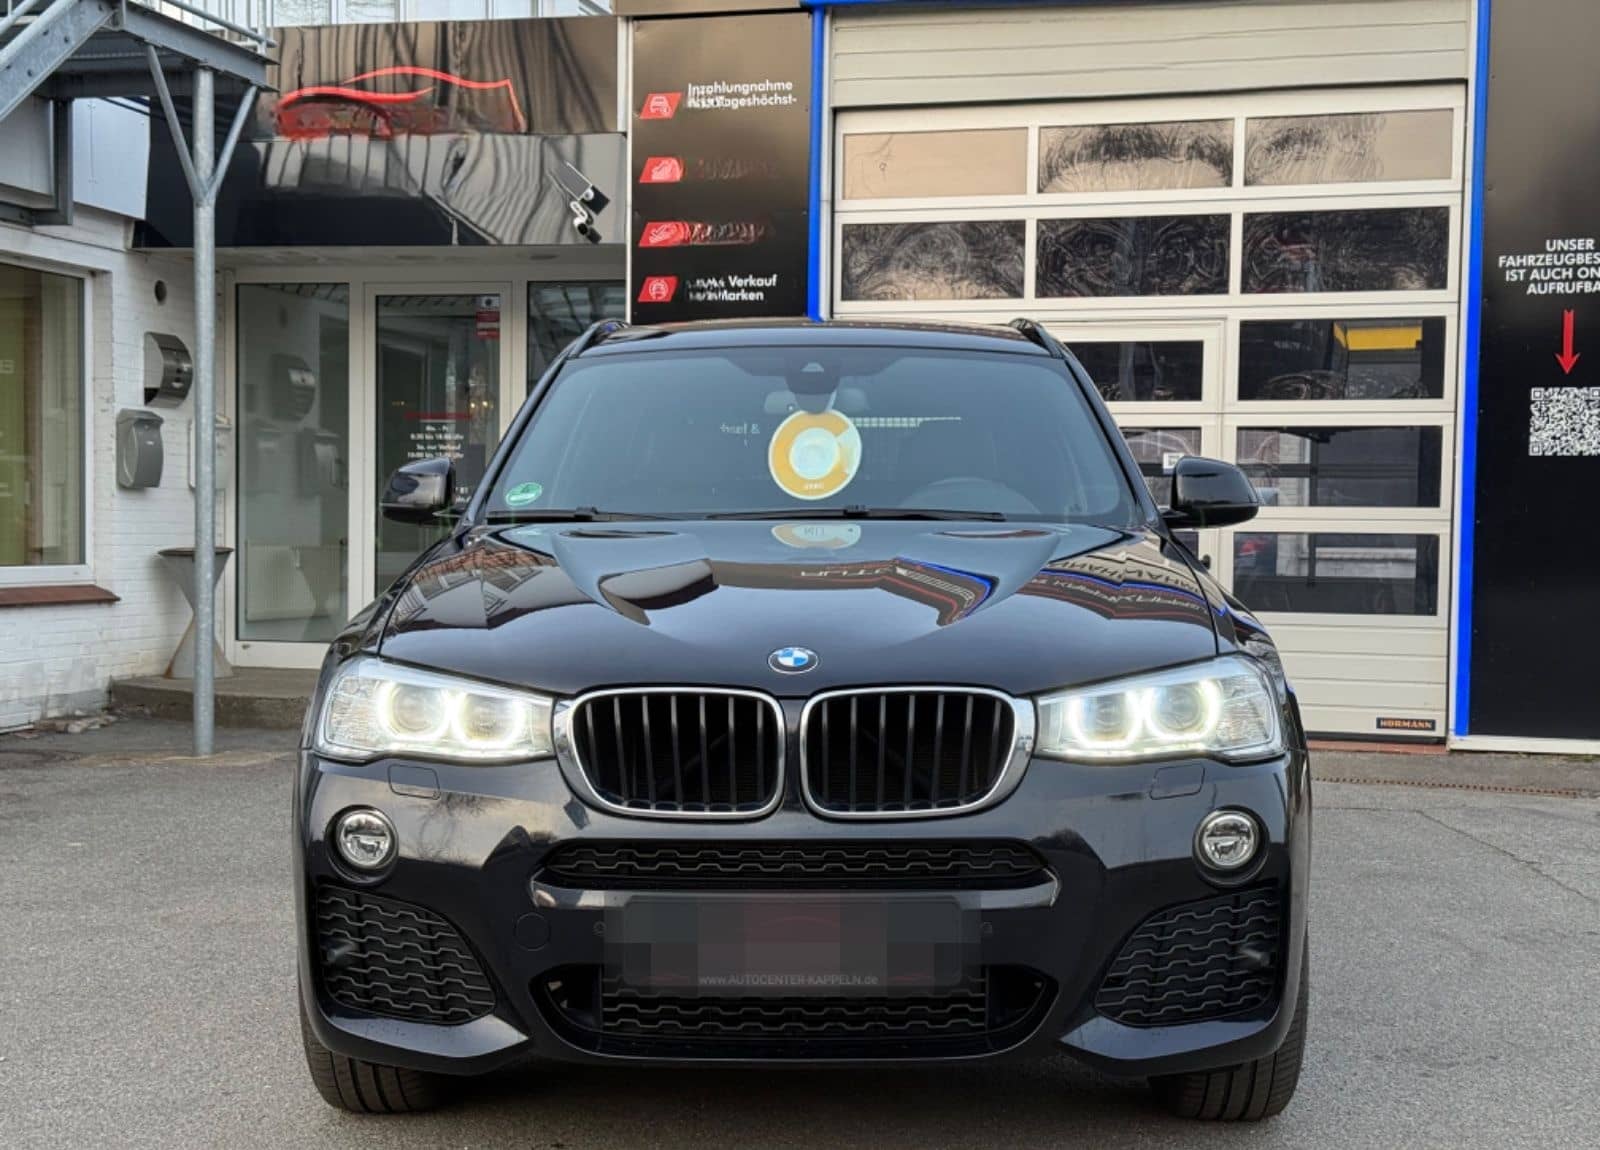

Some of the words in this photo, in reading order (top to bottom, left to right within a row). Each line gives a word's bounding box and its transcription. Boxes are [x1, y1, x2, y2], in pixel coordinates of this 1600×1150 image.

[1546, 238, 1595, 252] UNSER
[1498, 252, 1600, 268] FAHRZEUGBES
[728, 274, 777, 287] Verkauf
[1506, 269, 1526, 282] IST
[1530, 267, 1573, 281] AUCH
[1577, 266, 1600, 280] ON
[1526, 281, 1600, 295] AUFRUFBA
